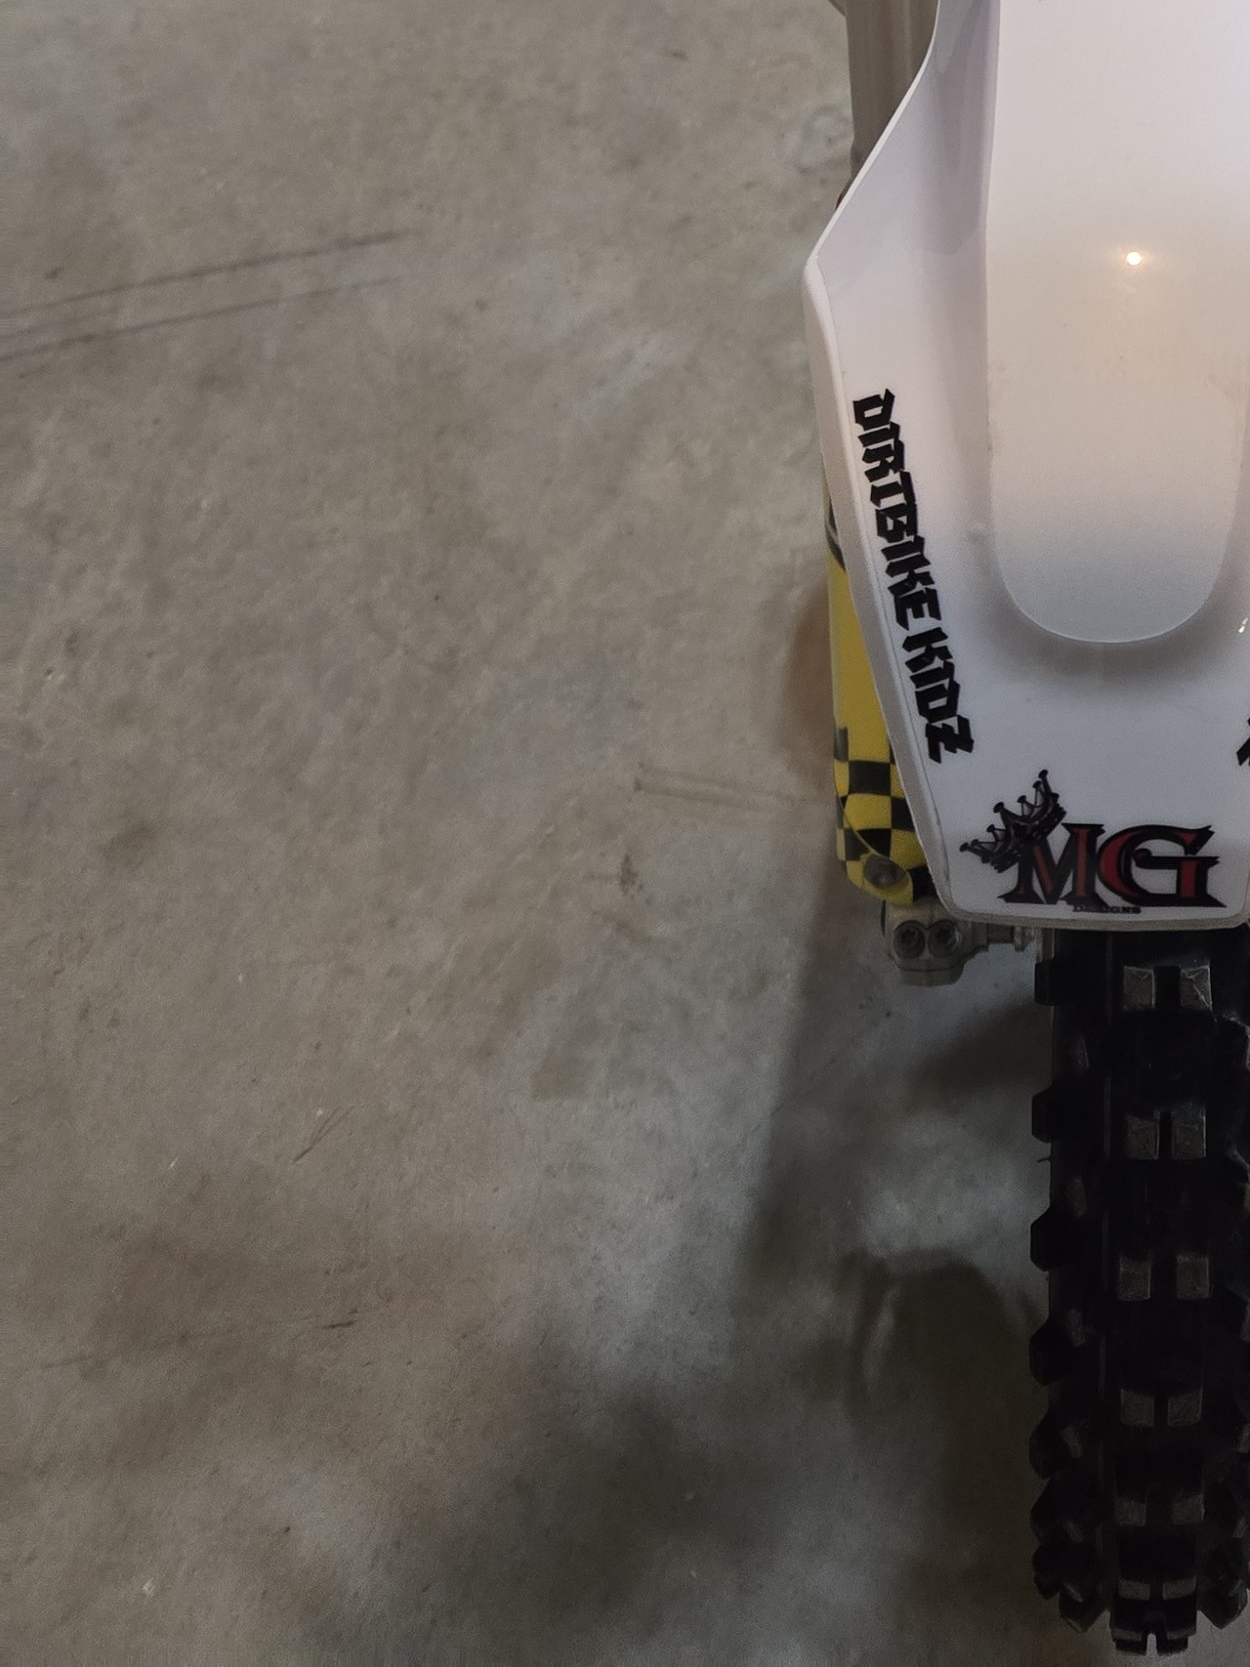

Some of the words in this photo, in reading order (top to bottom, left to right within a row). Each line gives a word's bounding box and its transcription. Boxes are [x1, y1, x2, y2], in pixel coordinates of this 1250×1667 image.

[852, 388, 941, 631] DIRTBIKE
[902, 627, 975, 764] KIDZ
[996, 822, 1227, 907] MG
